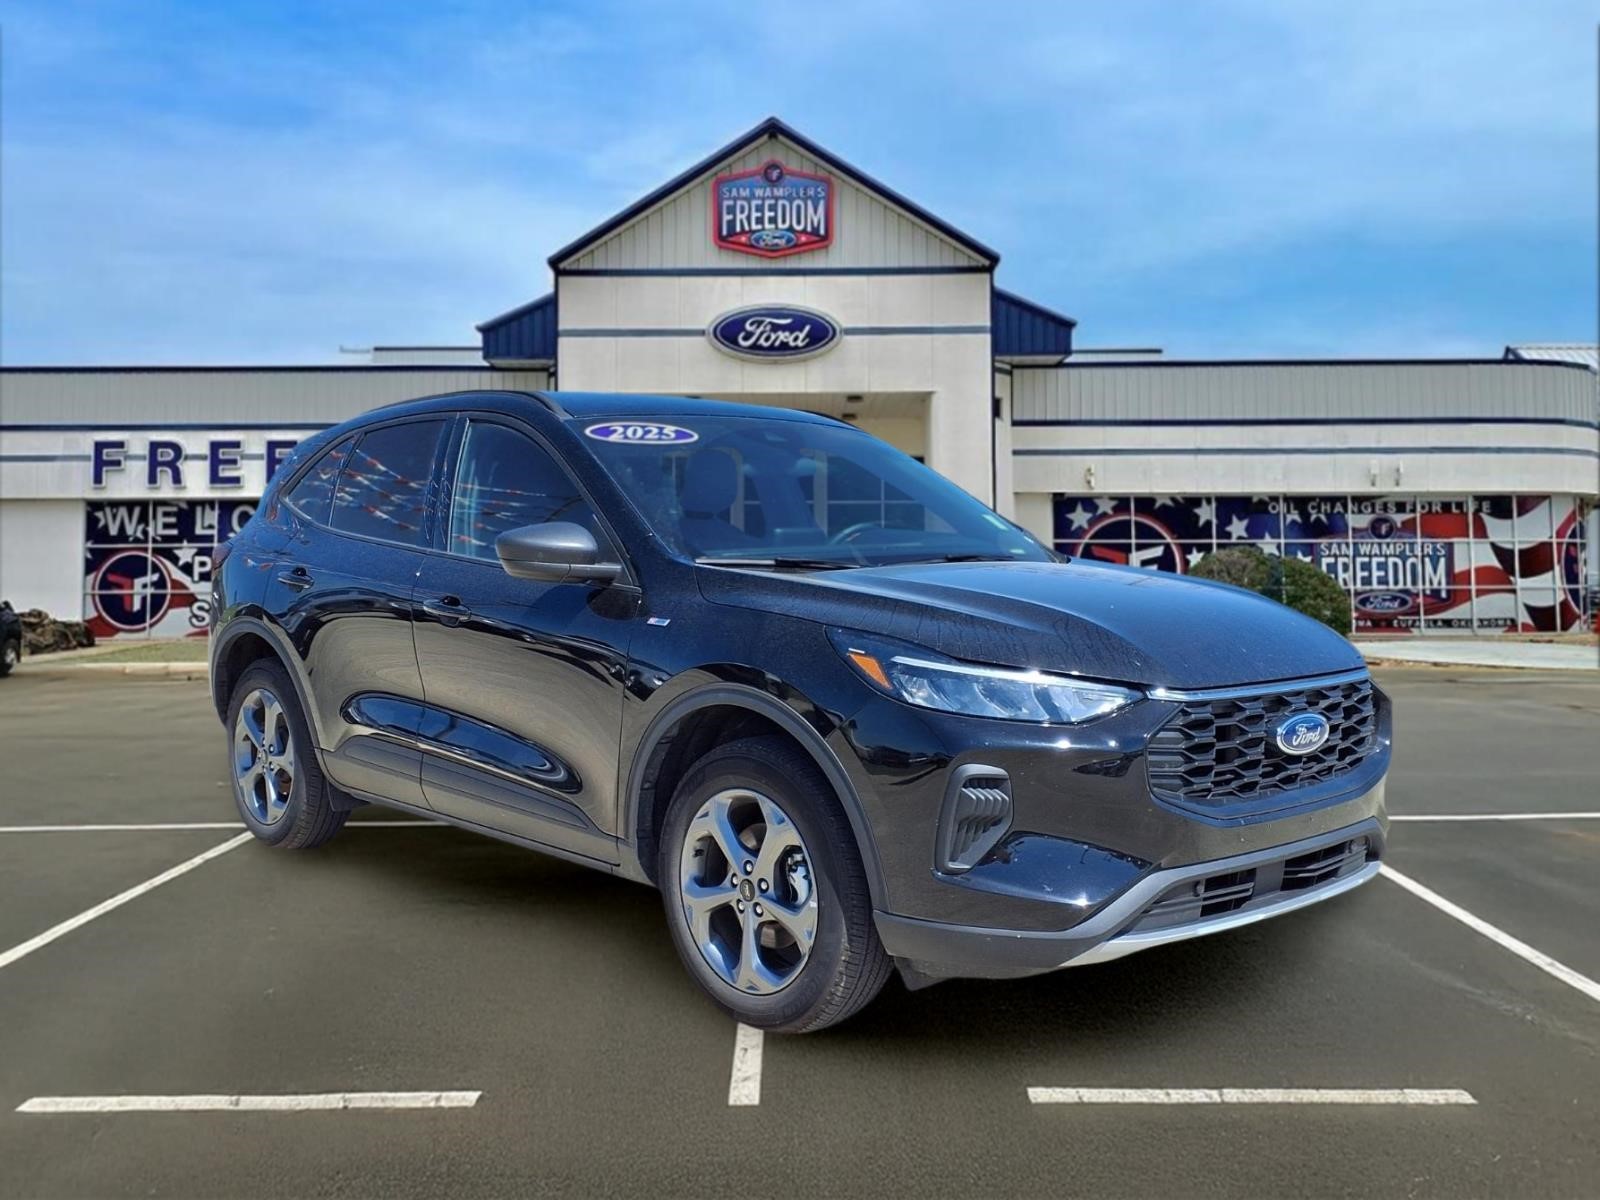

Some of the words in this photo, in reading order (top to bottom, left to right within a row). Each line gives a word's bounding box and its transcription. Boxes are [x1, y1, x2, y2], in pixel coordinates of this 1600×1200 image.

[722, 187, 750, 198] SAM
[722, 199, 825, 236] FREEDOM
[737, 316, 811, 347] Ford
[608, 425, 677, 440] 2025
[1268, 501, 1299, 514] OIL
[1308, 501, 1396, 514] CHANGES
[1406, 501, 1442, 513] FOR
[1452, 500, 1491, 513] LIFE
[1365, 595, 1399, 609] Ford
[1292, 722, 1321, 746] Ford
